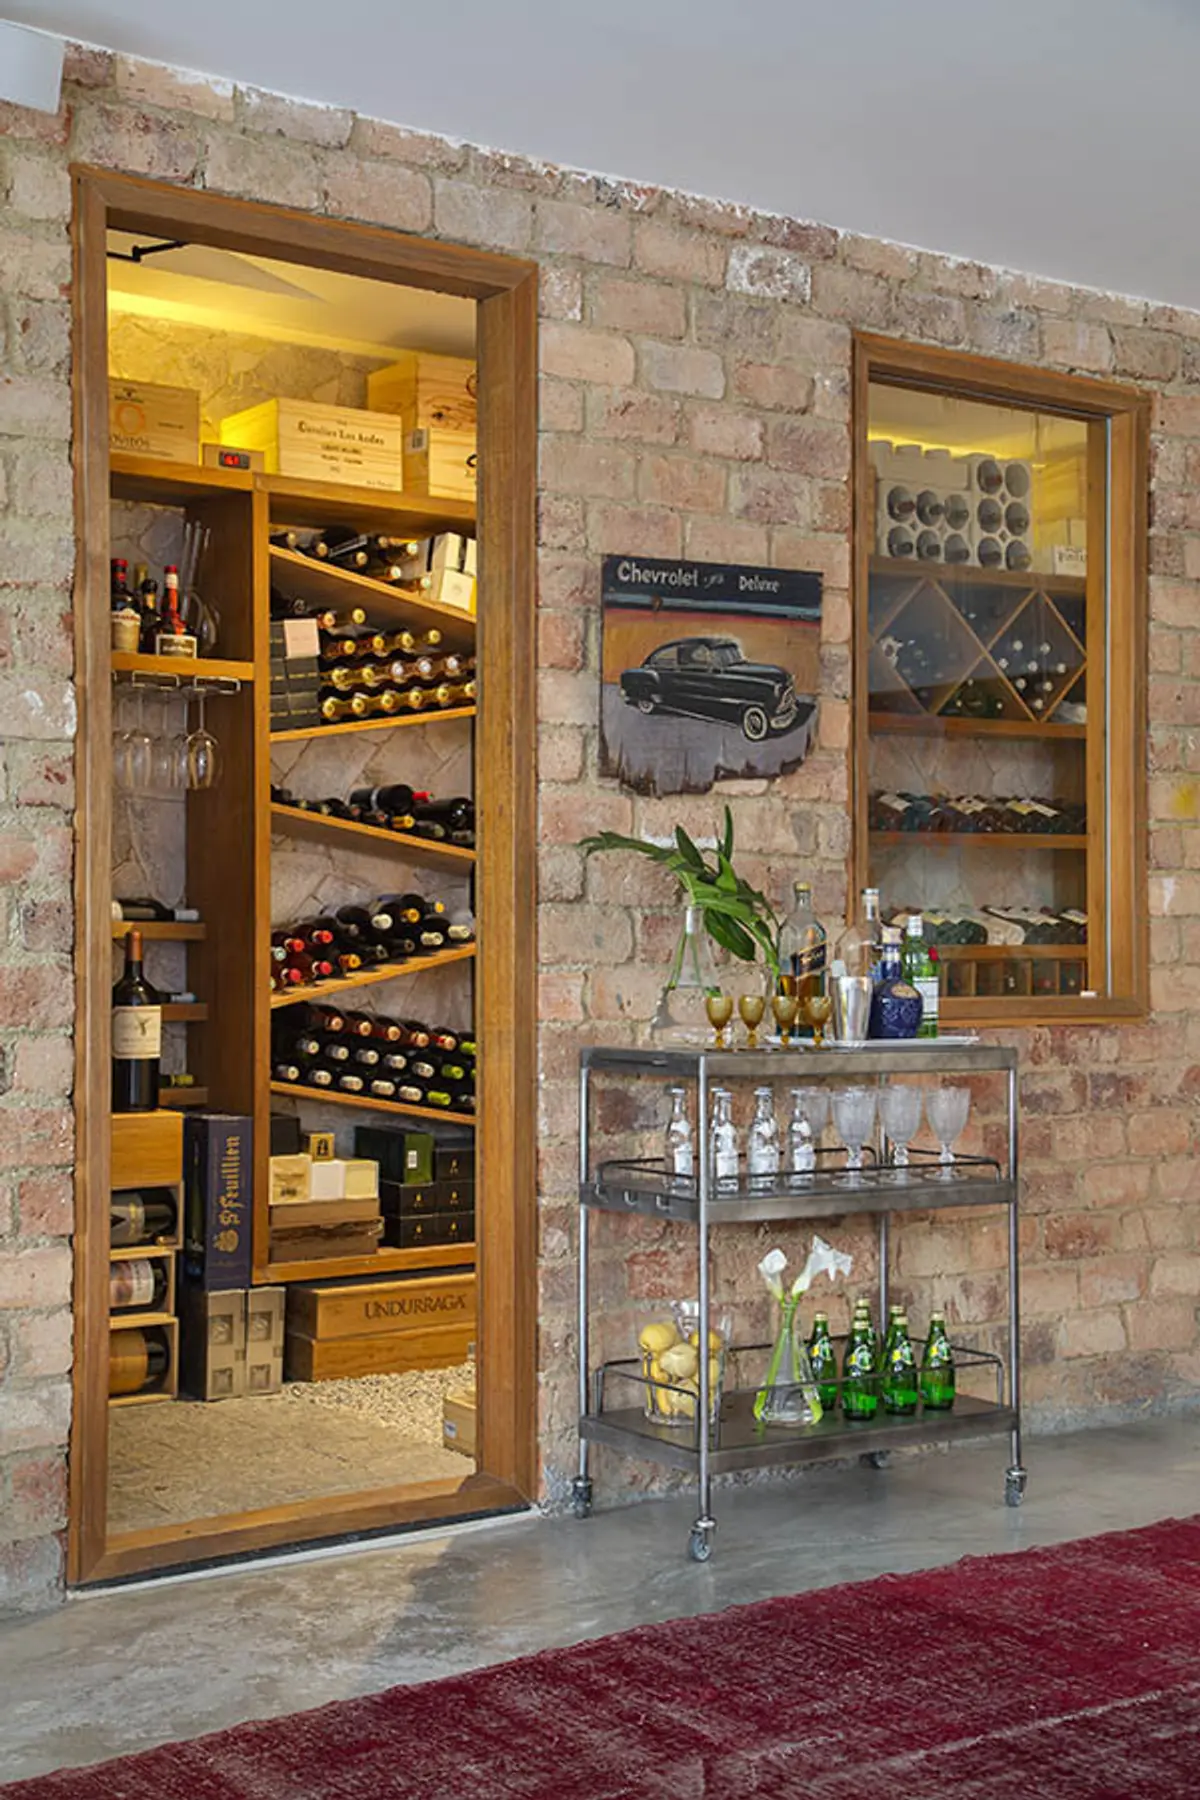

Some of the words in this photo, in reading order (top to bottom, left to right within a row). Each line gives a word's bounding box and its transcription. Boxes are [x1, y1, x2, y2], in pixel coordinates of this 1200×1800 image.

[616, 560, 699, 588] Chevrolet
[738, 574, 781, 594] Deluxe
[364, 1294, 467, 1320] UNDURRAGA
